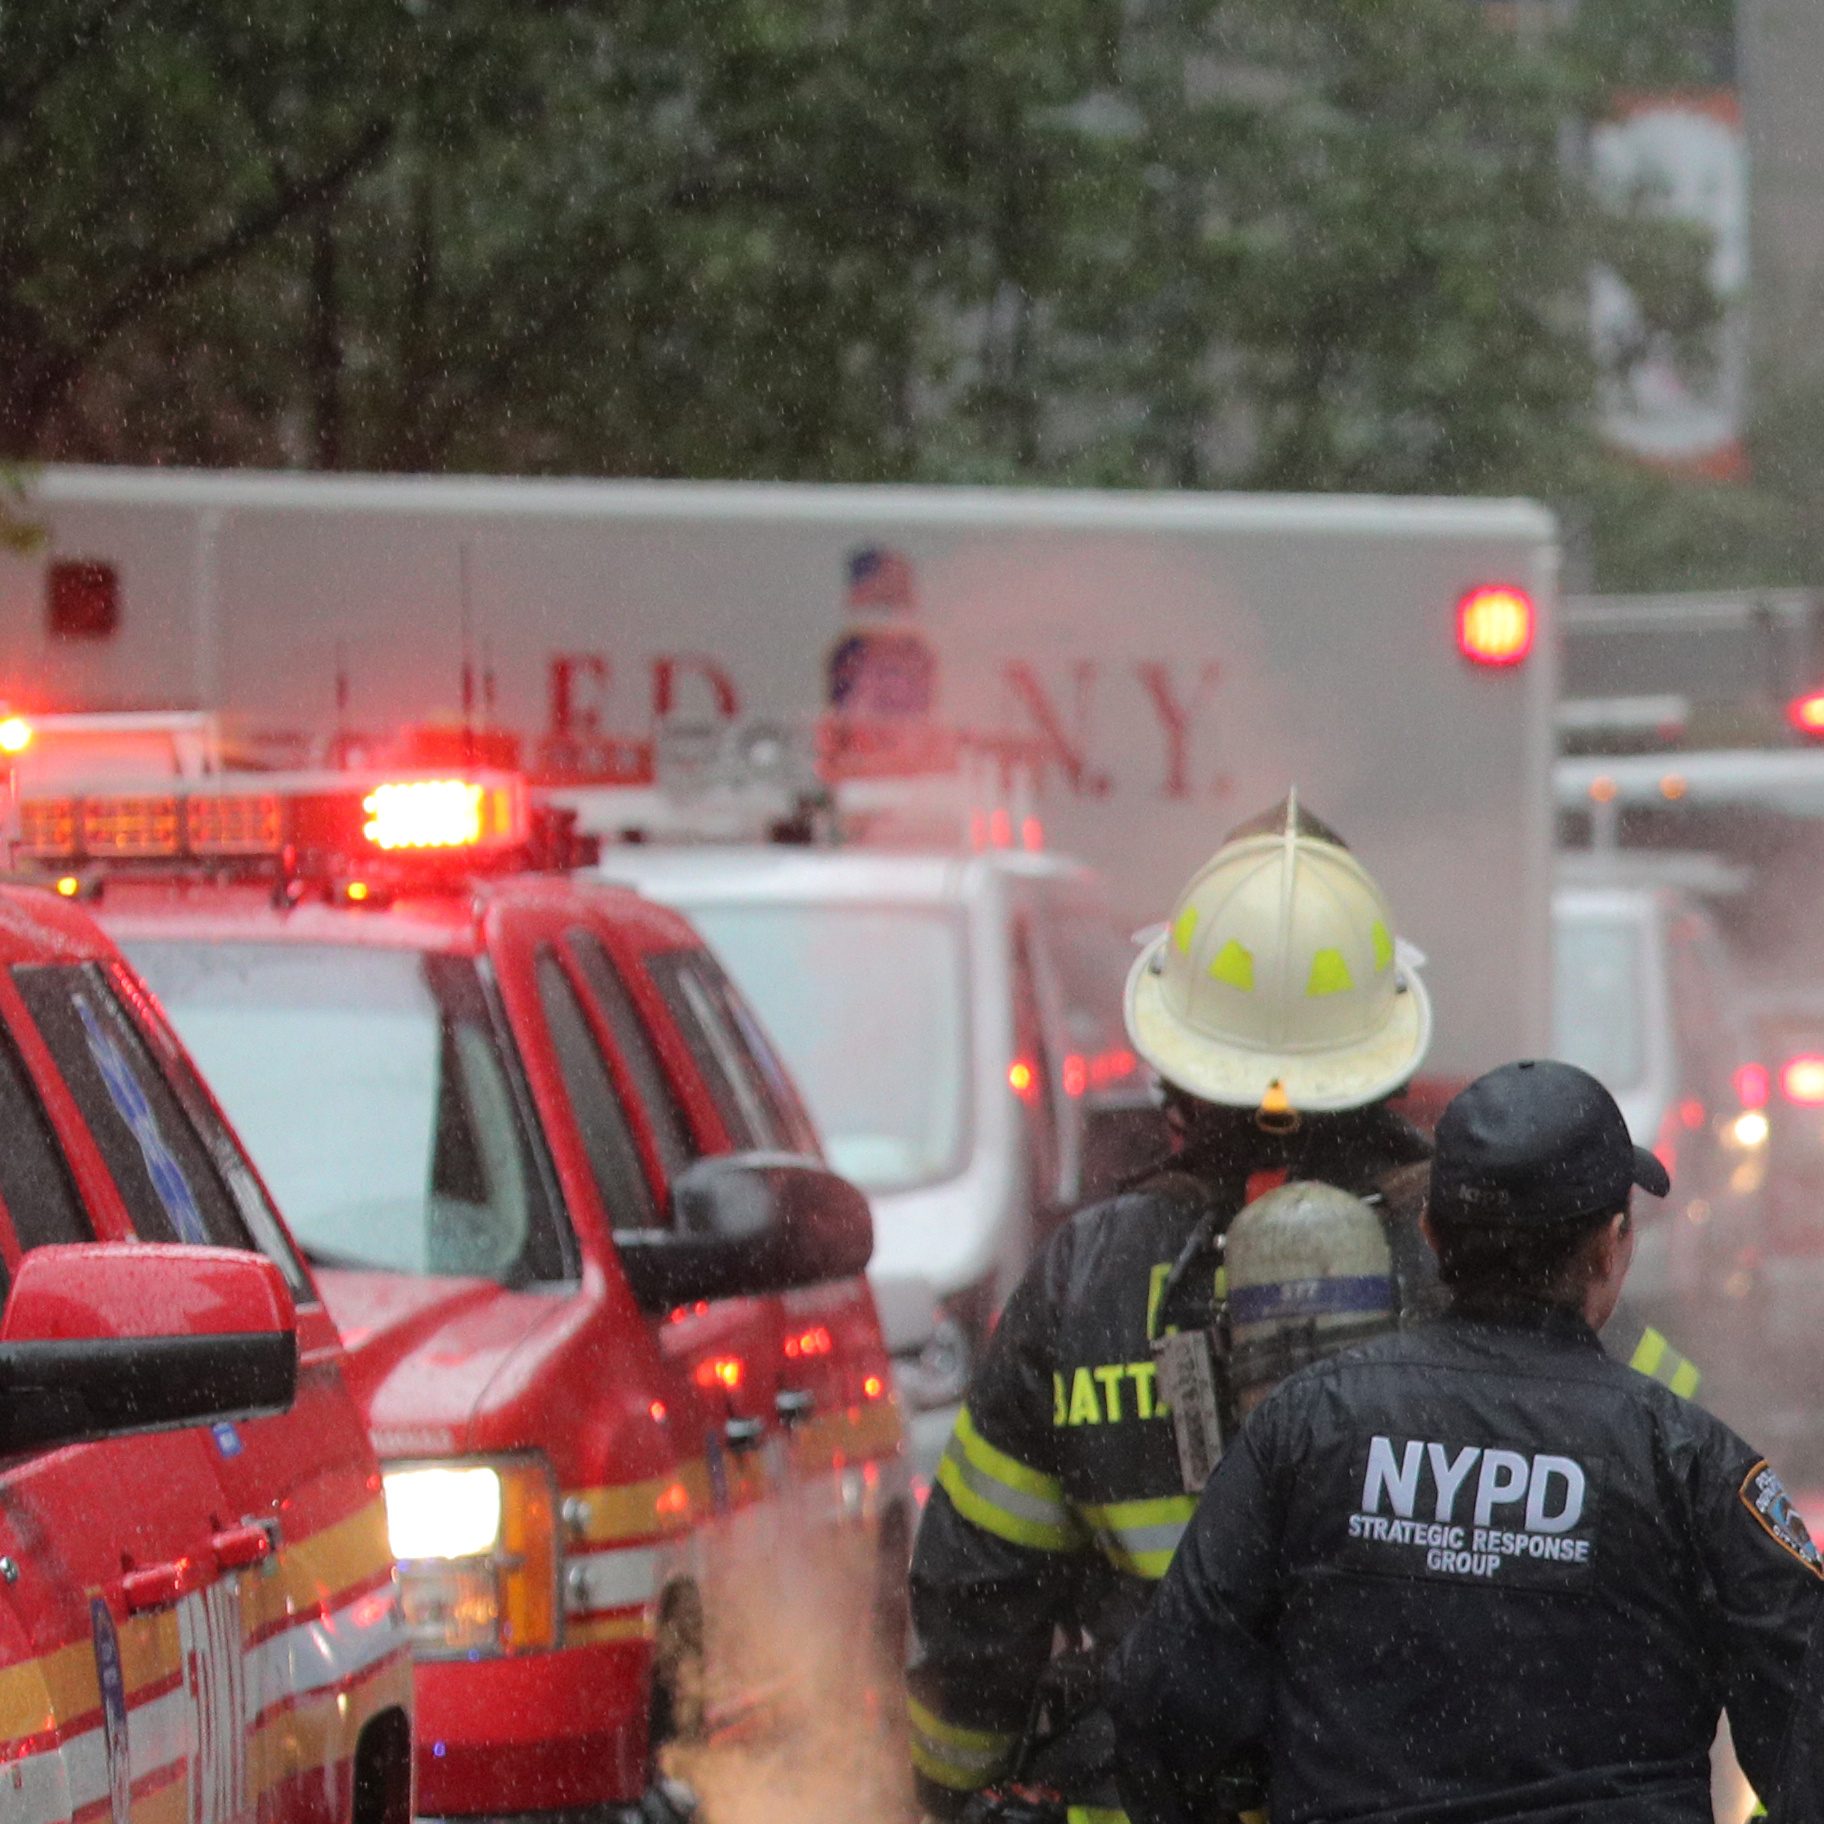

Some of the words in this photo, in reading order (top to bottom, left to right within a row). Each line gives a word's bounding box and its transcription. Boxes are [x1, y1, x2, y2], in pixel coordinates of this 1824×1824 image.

[1362, 1434, 1586, 1535] NYPD
[1348, 1513, 1466, 1552] STRATEGIC
[1471, 1526, 1589, 1564] RESPONSE
[1426, 1548, 1501, 1579] GROUP
